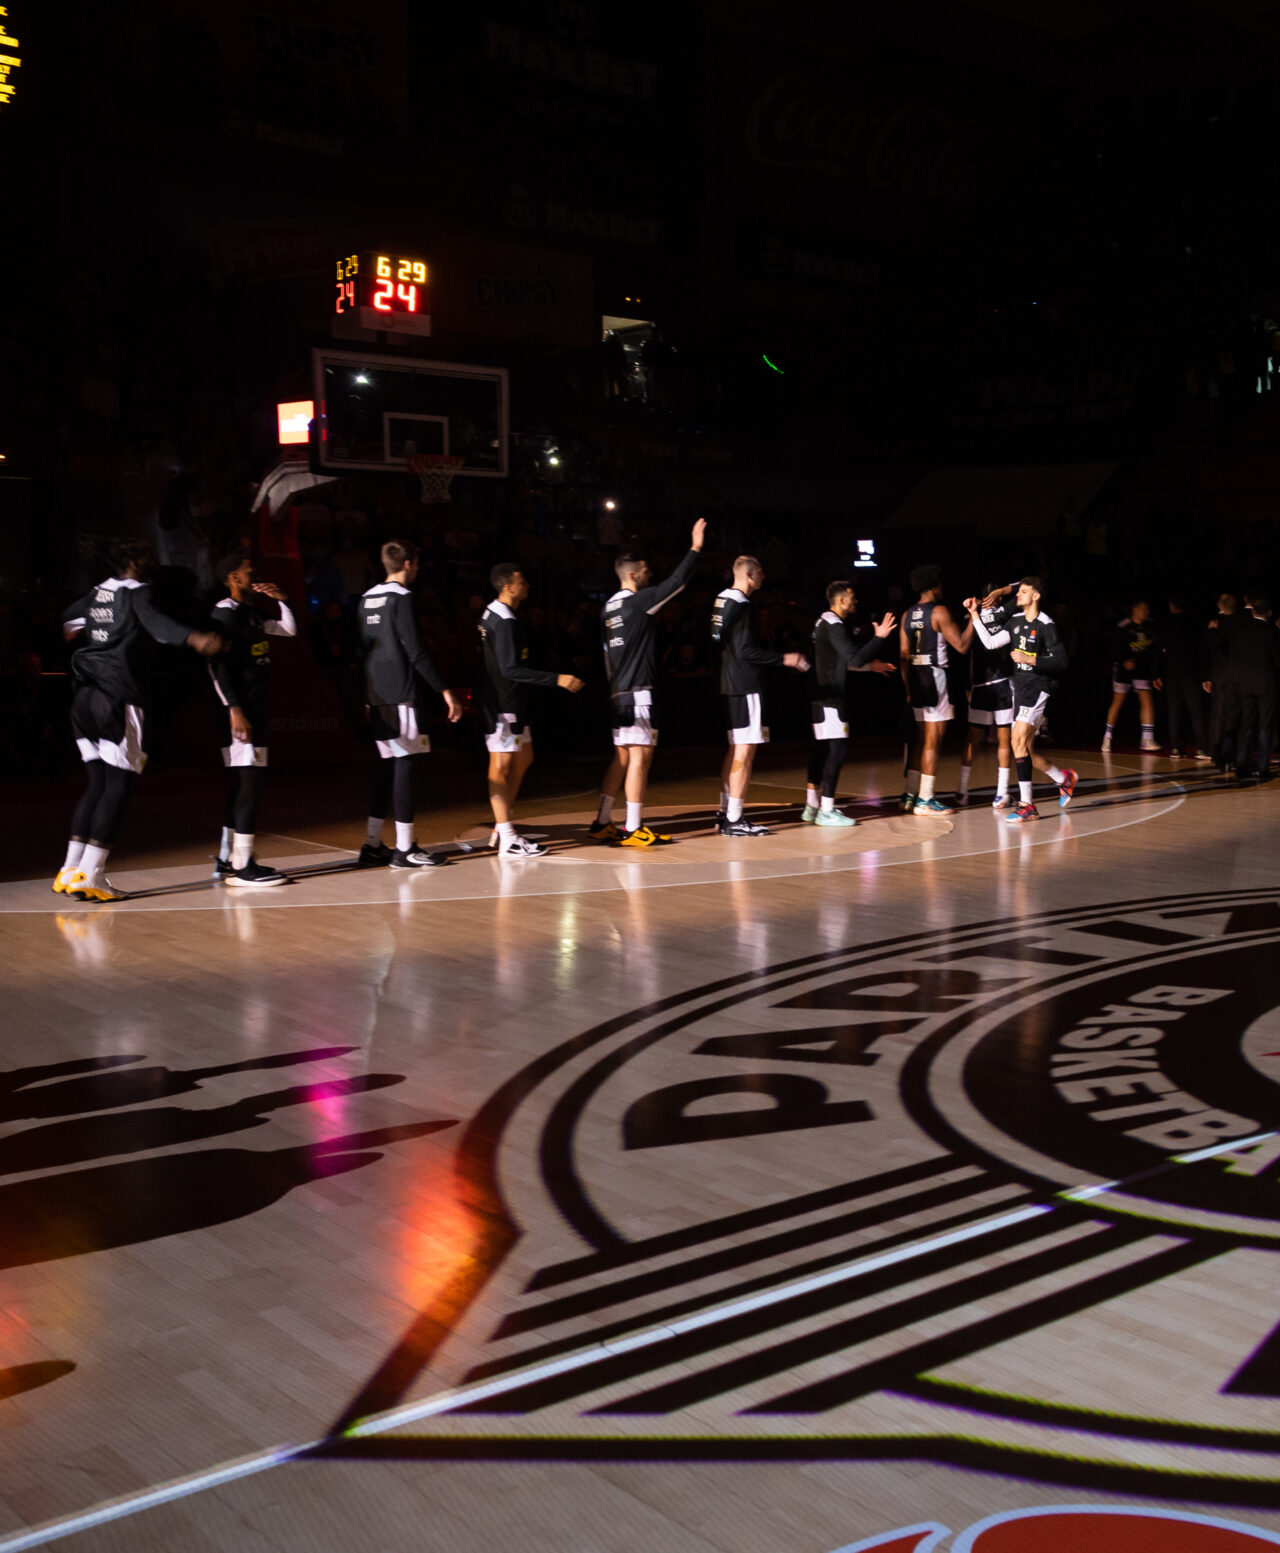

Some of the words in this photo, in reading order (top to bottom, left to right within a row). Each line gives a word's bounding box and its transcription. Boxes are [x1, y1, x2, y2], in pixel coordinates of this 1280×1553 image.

[397, 259, 427, 283] 29
[336, 280, 355, 314] 24
[374, 278, 416, 313] 24
[266, 712, 339, 733] eridian
